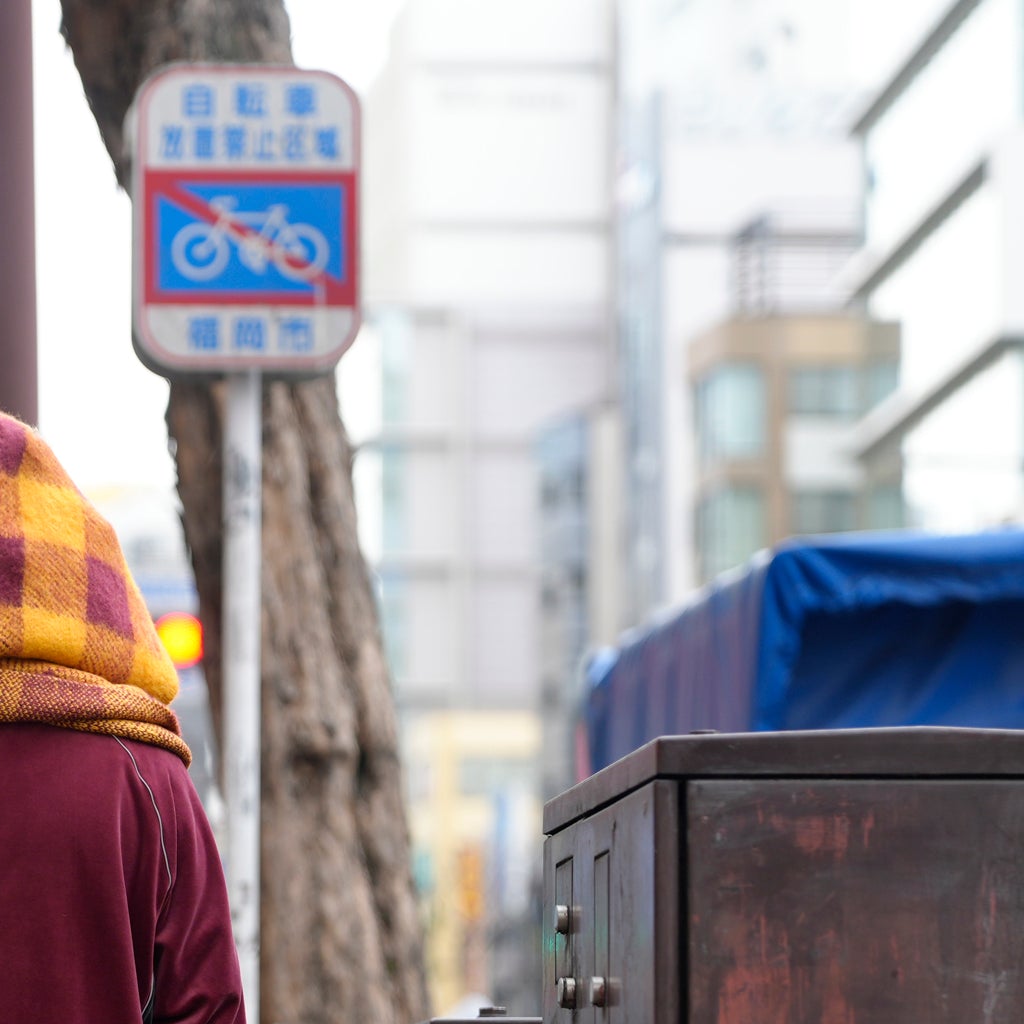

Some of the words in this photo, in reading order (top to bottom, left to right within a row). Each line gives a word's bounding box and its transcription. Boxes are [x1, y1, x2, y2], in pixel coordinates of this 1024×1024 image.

[183, 84, 315, 117] 自転車
[188, 316, 313, 351] 福岡市
